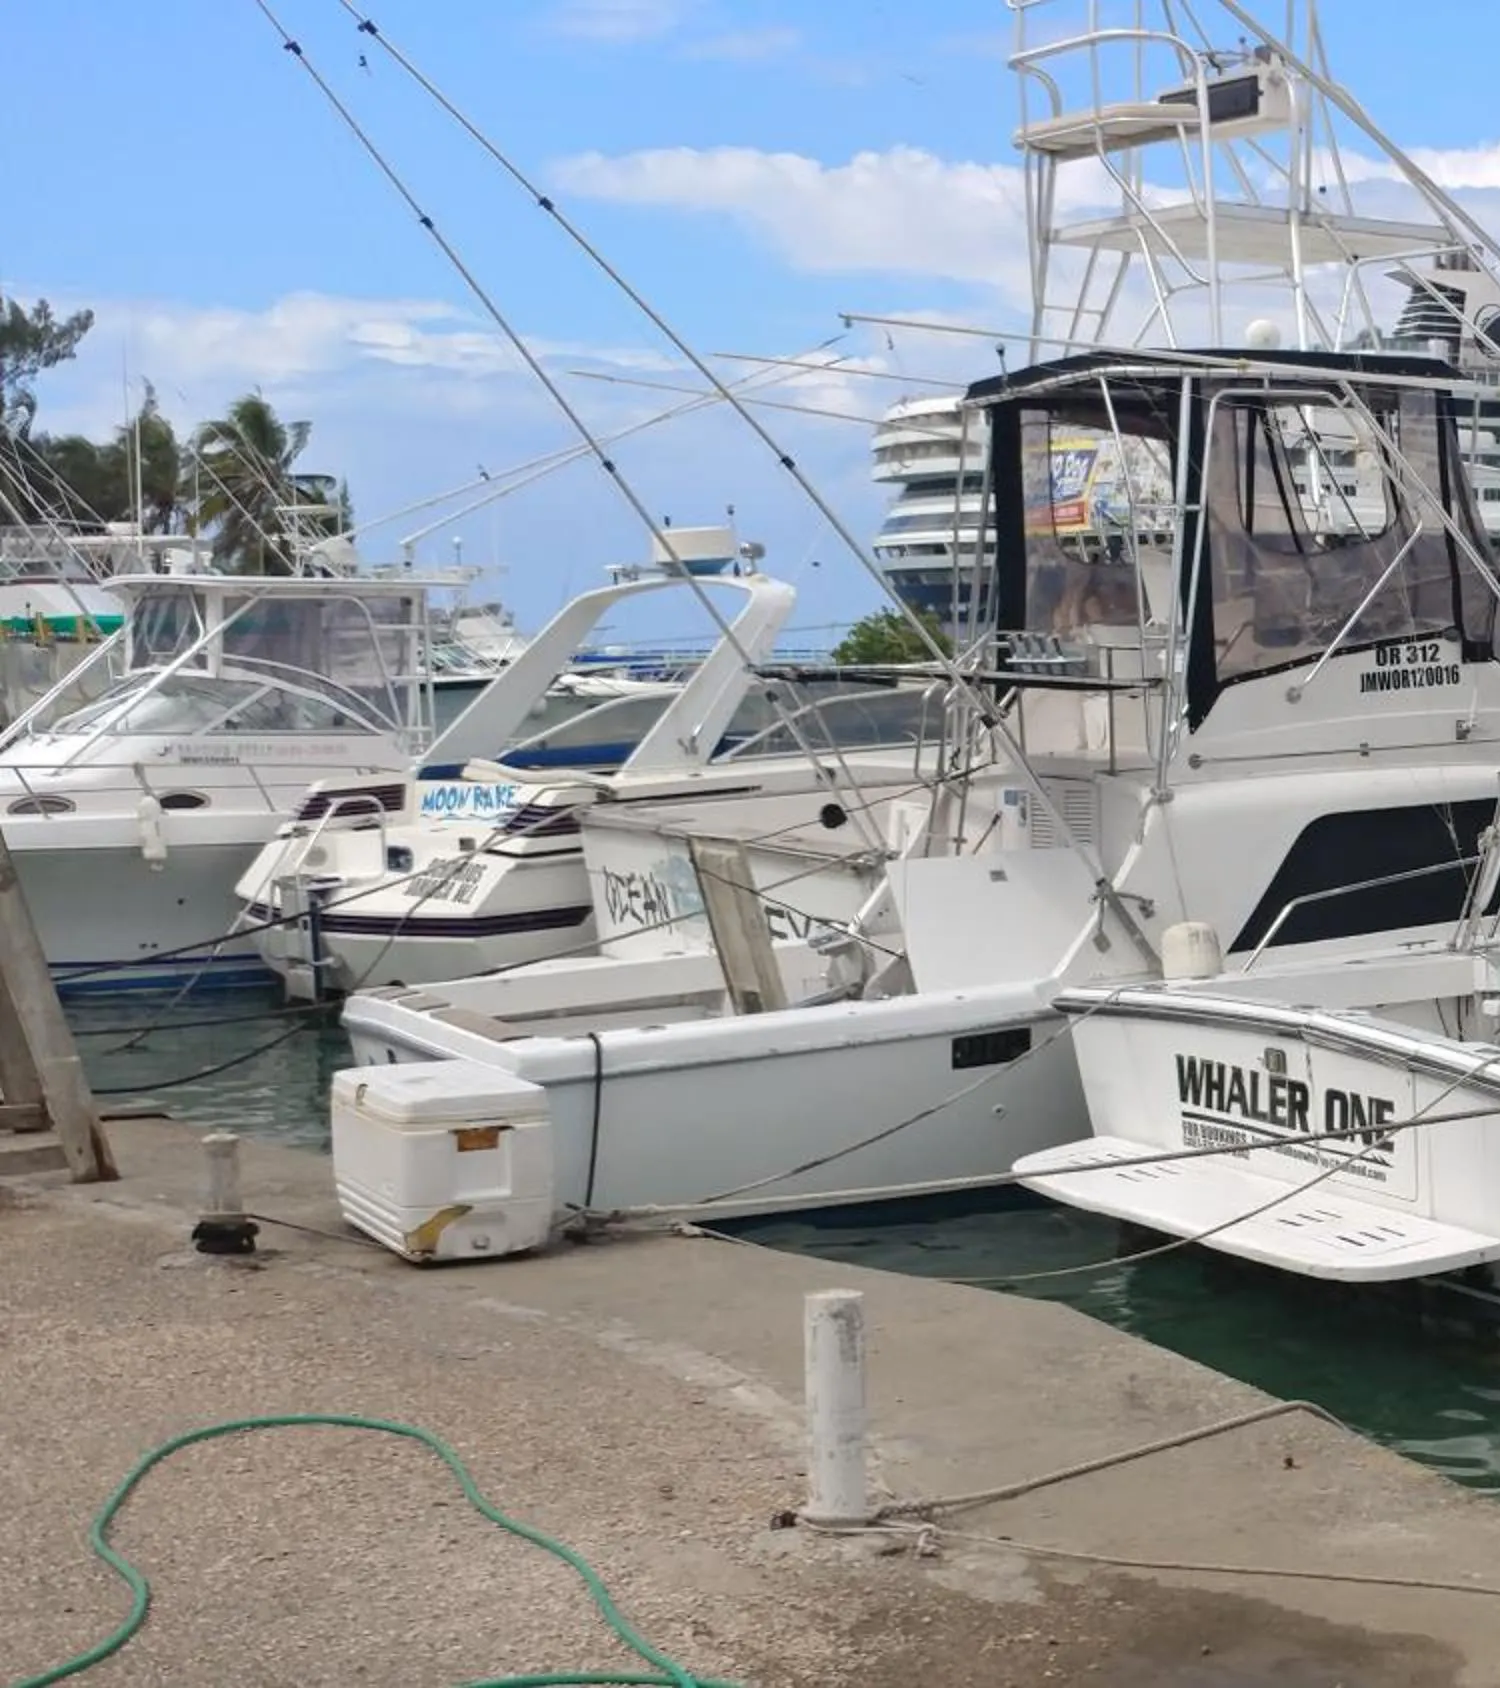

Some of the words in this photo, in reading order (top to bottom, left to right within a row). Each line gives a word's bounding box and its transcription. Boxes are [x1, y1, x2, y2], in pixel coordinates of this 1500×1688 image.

[1376, 648, 1401, 666] OR
[1406, 644, 1441, 664] 312
[421, 786, 470, 812] MOON
[602, 866, 670, 927] OCEAN
[1176, 1054, 1309, 1132] WHALER
[1325, 1088, 1395, 1153] ONE
